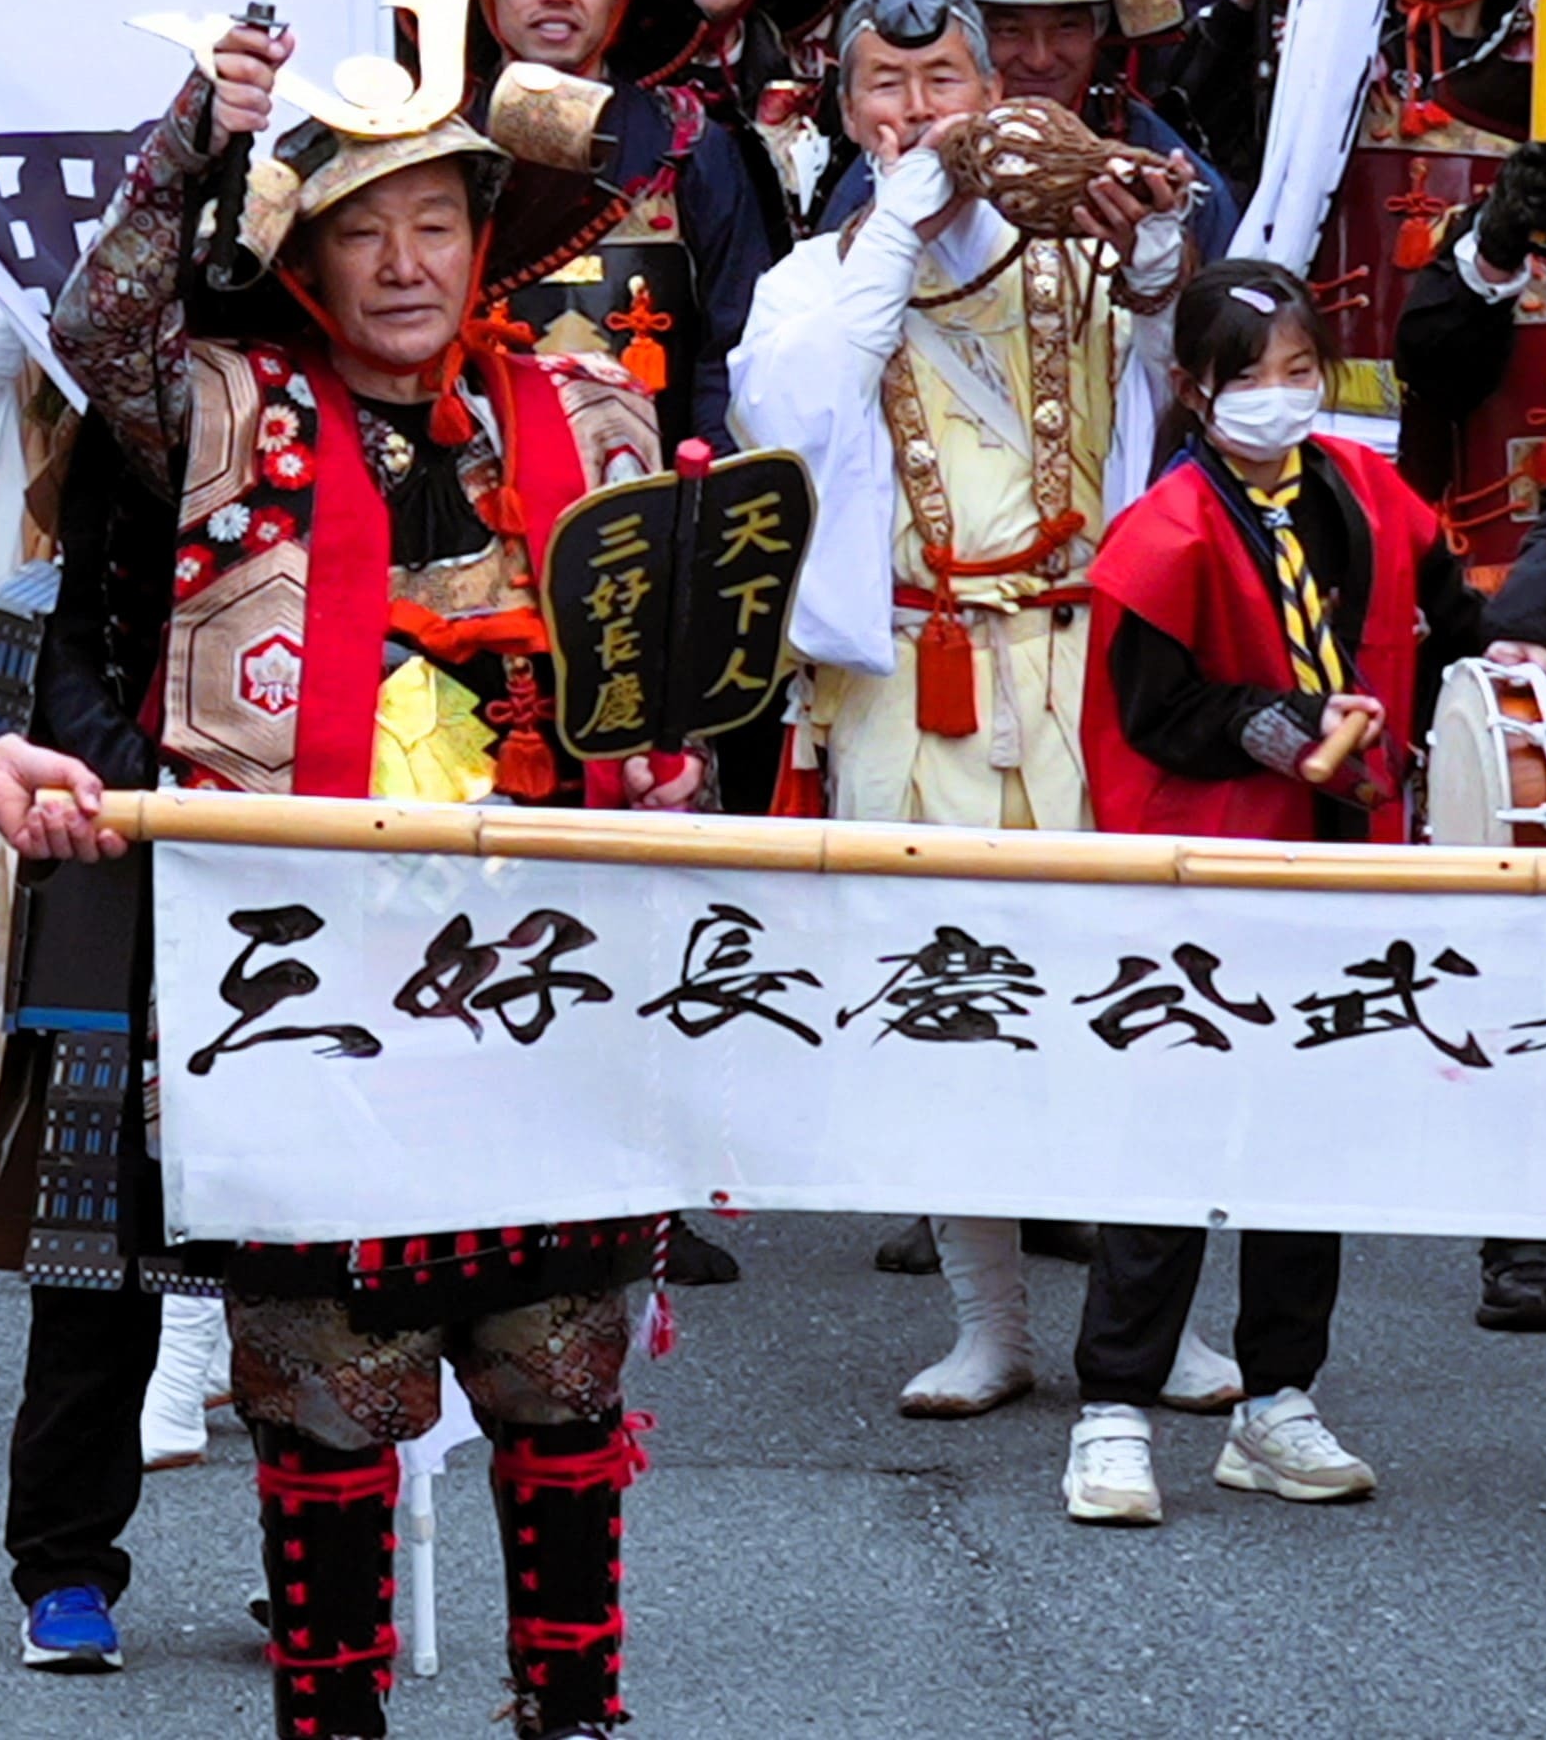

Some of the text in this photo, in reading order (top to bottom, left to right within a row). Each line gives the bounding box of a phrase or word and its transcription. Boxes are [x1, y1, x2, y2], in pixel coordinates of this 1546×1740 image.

[576, 512, 652, 741] 三好長慶
[703, 491, 792, 700] 天下人
